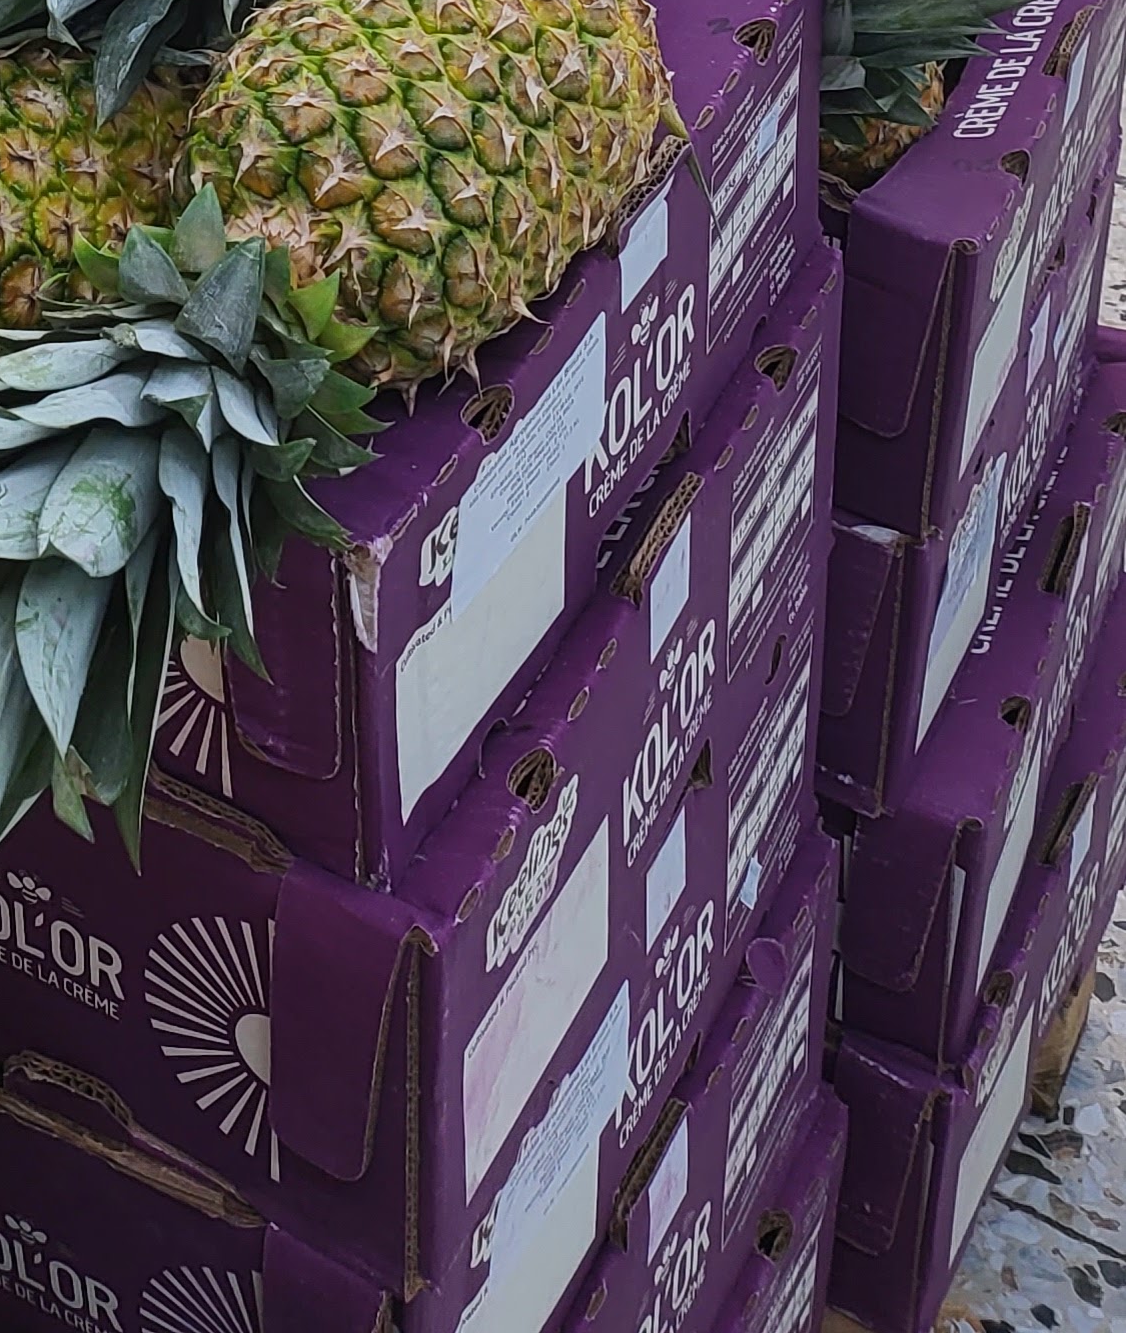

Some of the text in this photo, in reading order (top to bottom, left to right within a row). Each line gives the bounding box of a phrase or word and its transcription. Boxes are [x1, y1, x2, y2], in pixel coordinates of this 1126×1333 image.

[986, 54, 1034, 82] DE
[999, 28, 1046, 55] LA
[589, 352, 692, 518] CRÈME DE LA CRÈME
[624, 619, 716, 848] KOL'OR
[628, 685, 713, 868] CRÈME DE LA CRÈME
[491, 800, 572, 941] Keelings
[11, 951, 34, 977] DE
[38, 964, 60, 989] LA
[63, 977, 120, 1021] CRÈME
[619, 962, 711, 1149] CRÈME DE LA CRÈME
[15, 1283, 37, 1306] DE
[39, 1295, 62, 1320] LA
